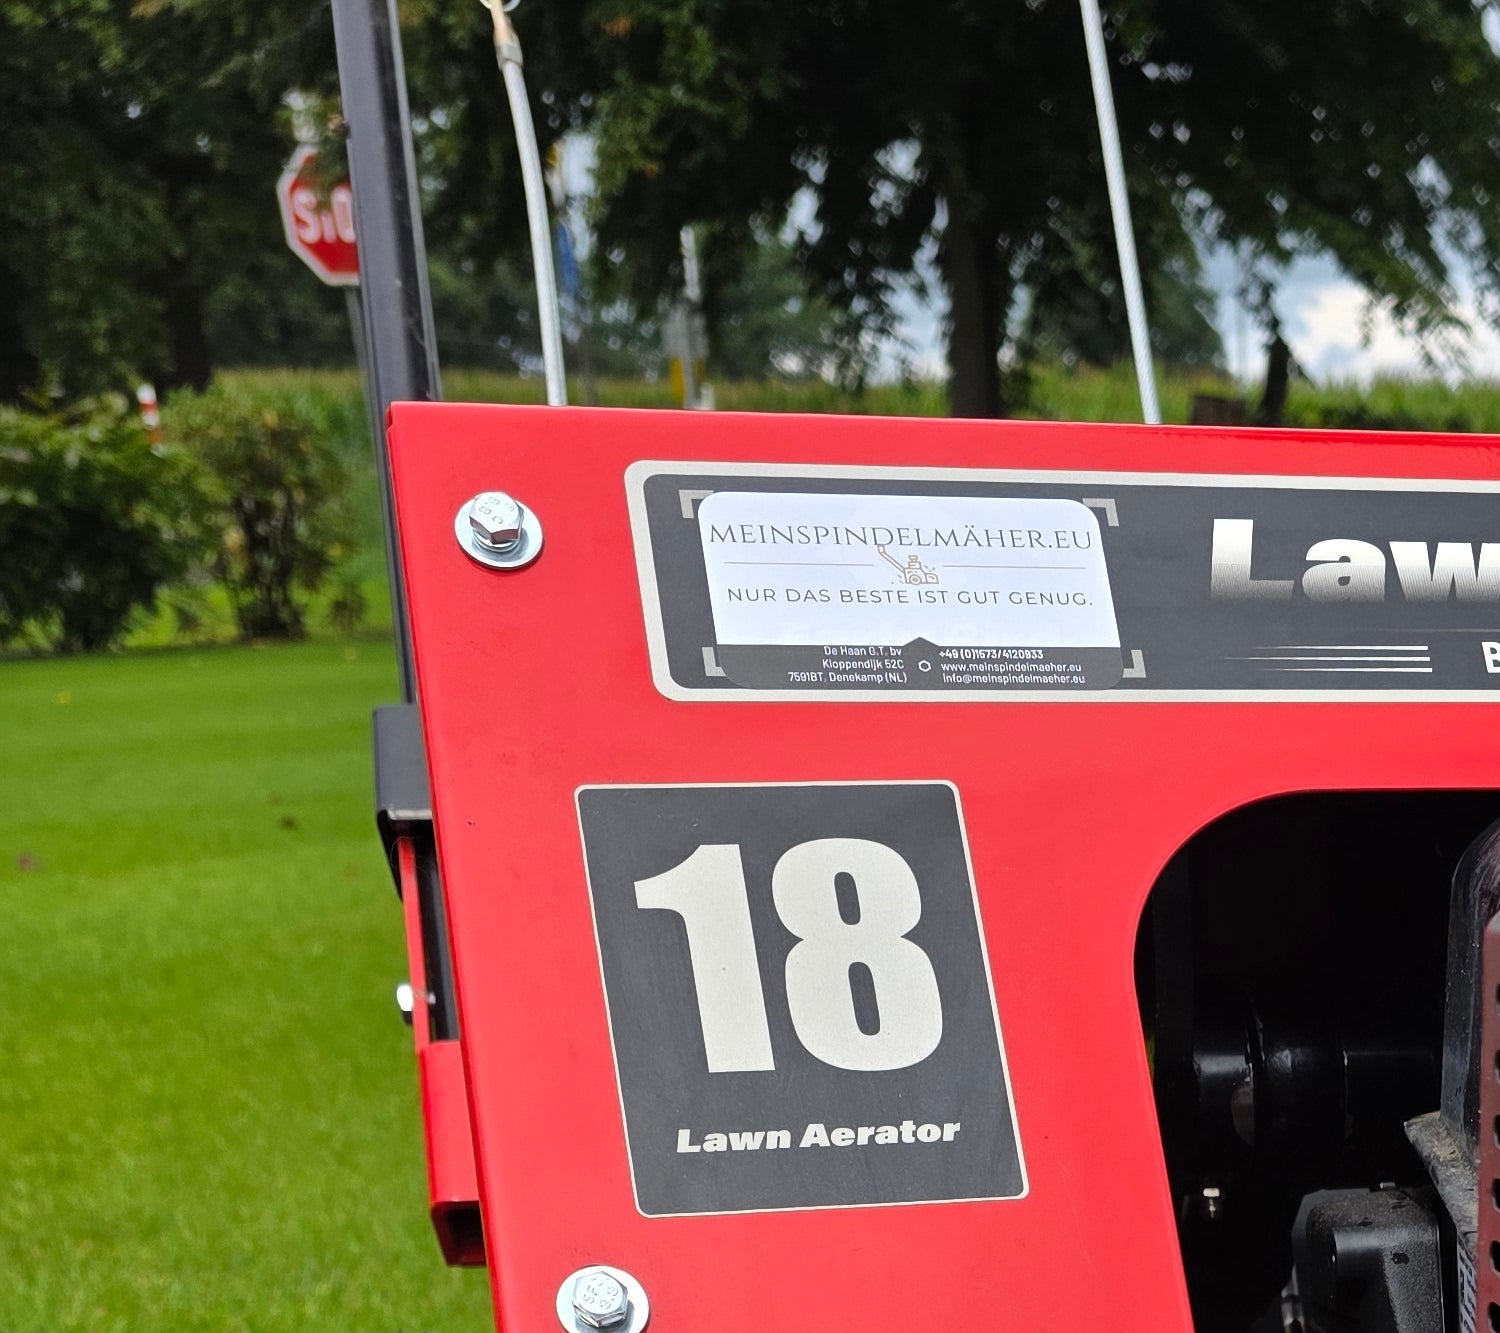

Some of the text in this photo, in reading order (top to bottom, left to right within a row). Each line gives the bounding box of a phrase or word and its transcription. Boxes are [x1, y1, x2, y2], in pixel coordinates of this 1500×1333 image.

[709, 523, 1092, 551] MEINSPINDELMÄHER.EU
[727, 588, 1093, 606] NUR DAS BESTE IST GUT GENUG.
[824, 646, 837, 655] De
[840, 646, 866, 656] Haan
[890, 647, 901, 656] bv
[939, 649, 958, 659] +49
[885, 660, 904, 669] 52C
[941, 662, 1081, 673] www.meinspindelmaeher.eu
[829, 672, 883, 684] Denekamp
[885, 672, 907, 683] (NL)
[943, 673, 1085, 685] info@meinspindelmaeher.eu
[634, 838, 942, 1073] 18
[677, 1120, 961, 1153] Lawn Aerator
